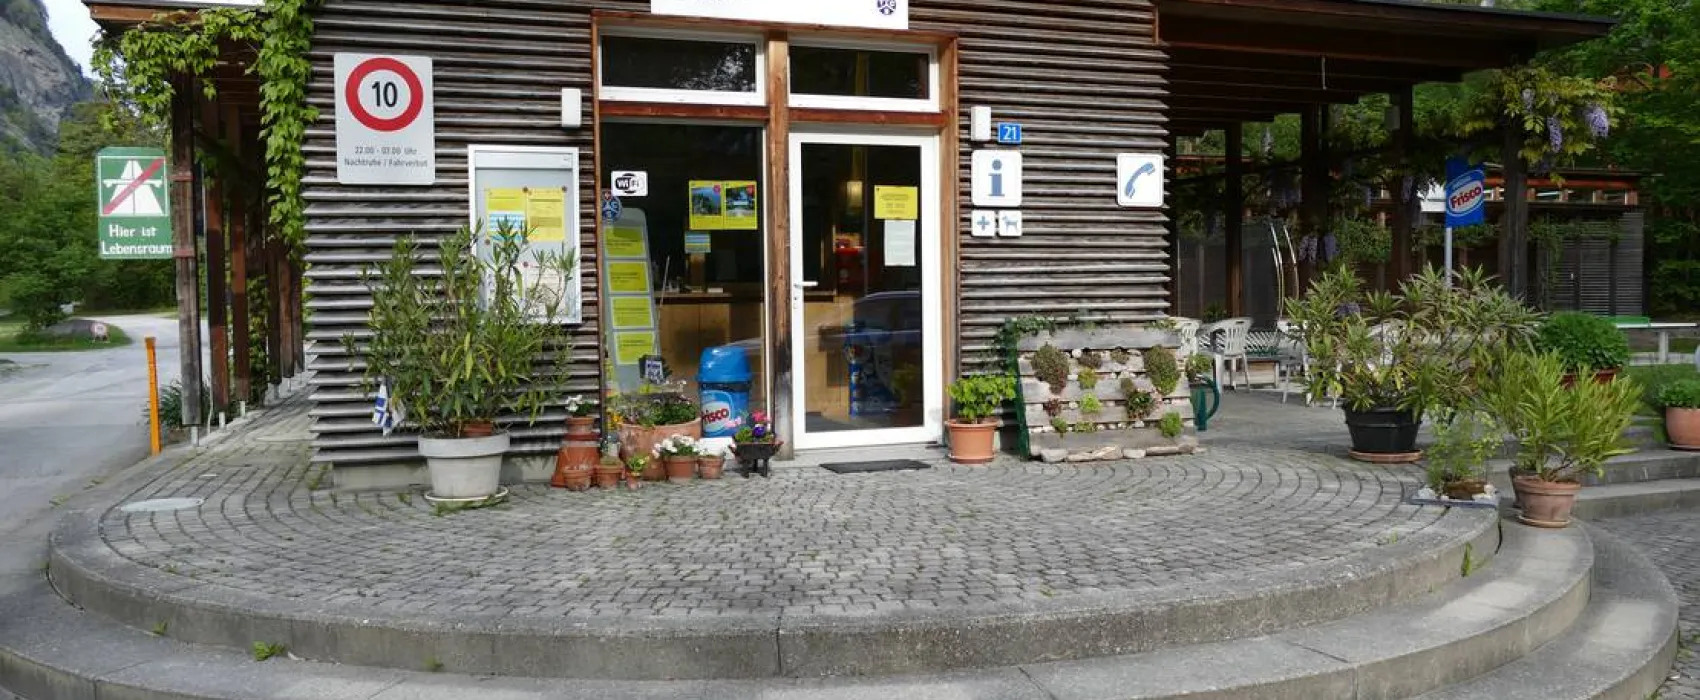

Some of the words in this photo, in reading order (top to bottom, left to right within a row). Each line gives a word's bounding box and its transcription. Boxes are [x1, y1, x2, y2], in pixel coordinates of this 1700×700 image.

[372, 81, 398, 107] 10
[1003, 126, 1017, 140] 21
[404, 146, 418, 154] Uhr
[344, 158, 381, 166] Nachtruhe
[389, 159, 428, 168] Fahrverbot
[1450, 186, 1481, 209] Frisco
[109, 224, 136, 238] Hier
[141, 226, 158, 237] ist
[101, 240, 173, 255] Lebensraum
[701, 407, 730, 424] risco
